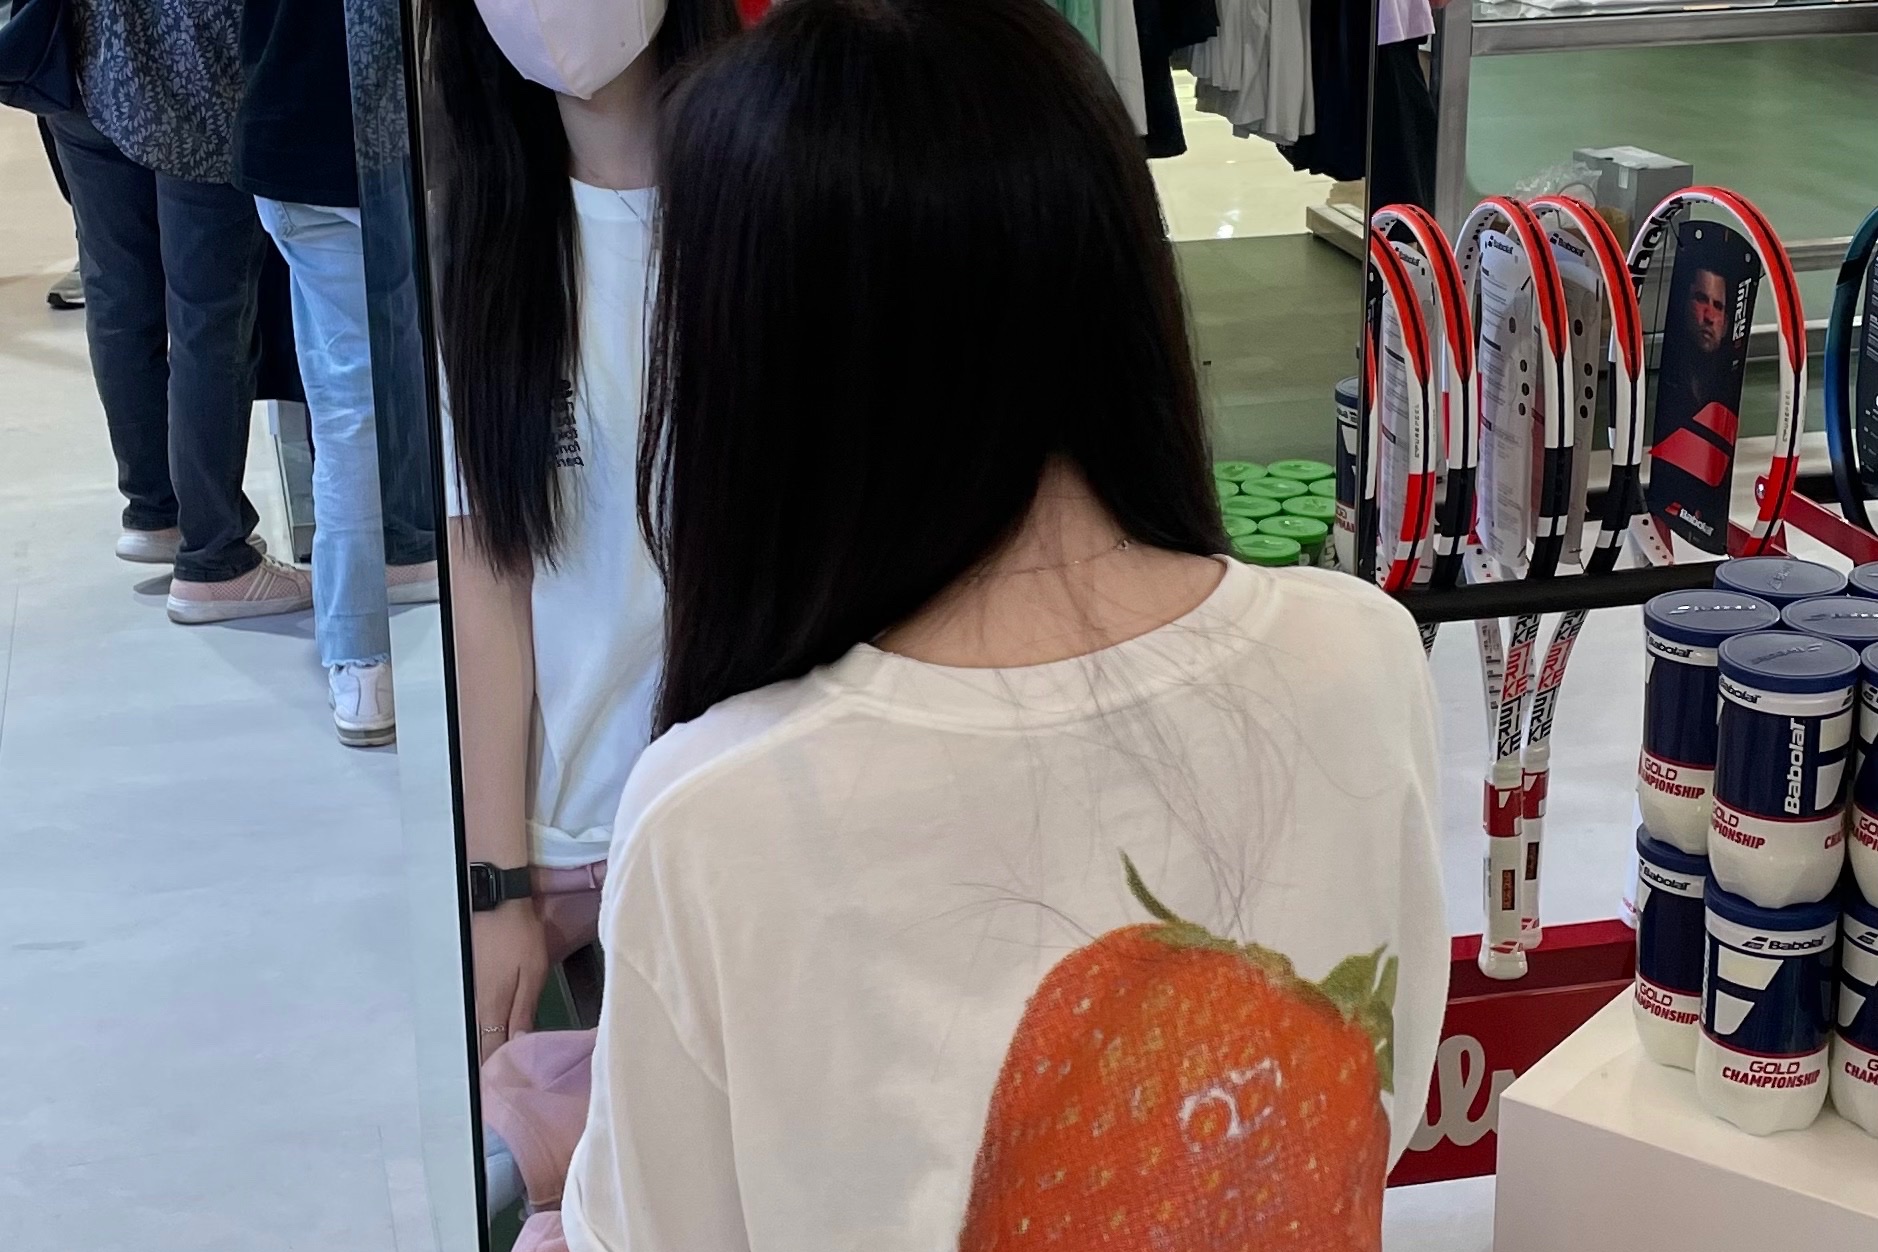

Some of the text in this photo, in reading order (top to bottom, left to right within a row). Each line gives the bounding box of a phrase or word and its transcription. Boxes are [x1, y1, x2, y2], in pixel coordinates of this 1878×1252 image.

[1644, 757, 1678, 781] GOLD
[1784, 718, 1806, 815] Babolat
[1643, 866, 1691, 890] Babolat
[1768, 935, 1826, 951] Babolat
[1640, 983, 1673, 1007] GOLD
[1722, 1066, 1821, 1088] CHAMPIONSHIP
[1749, 1060, 1800, 1075] GOLD
